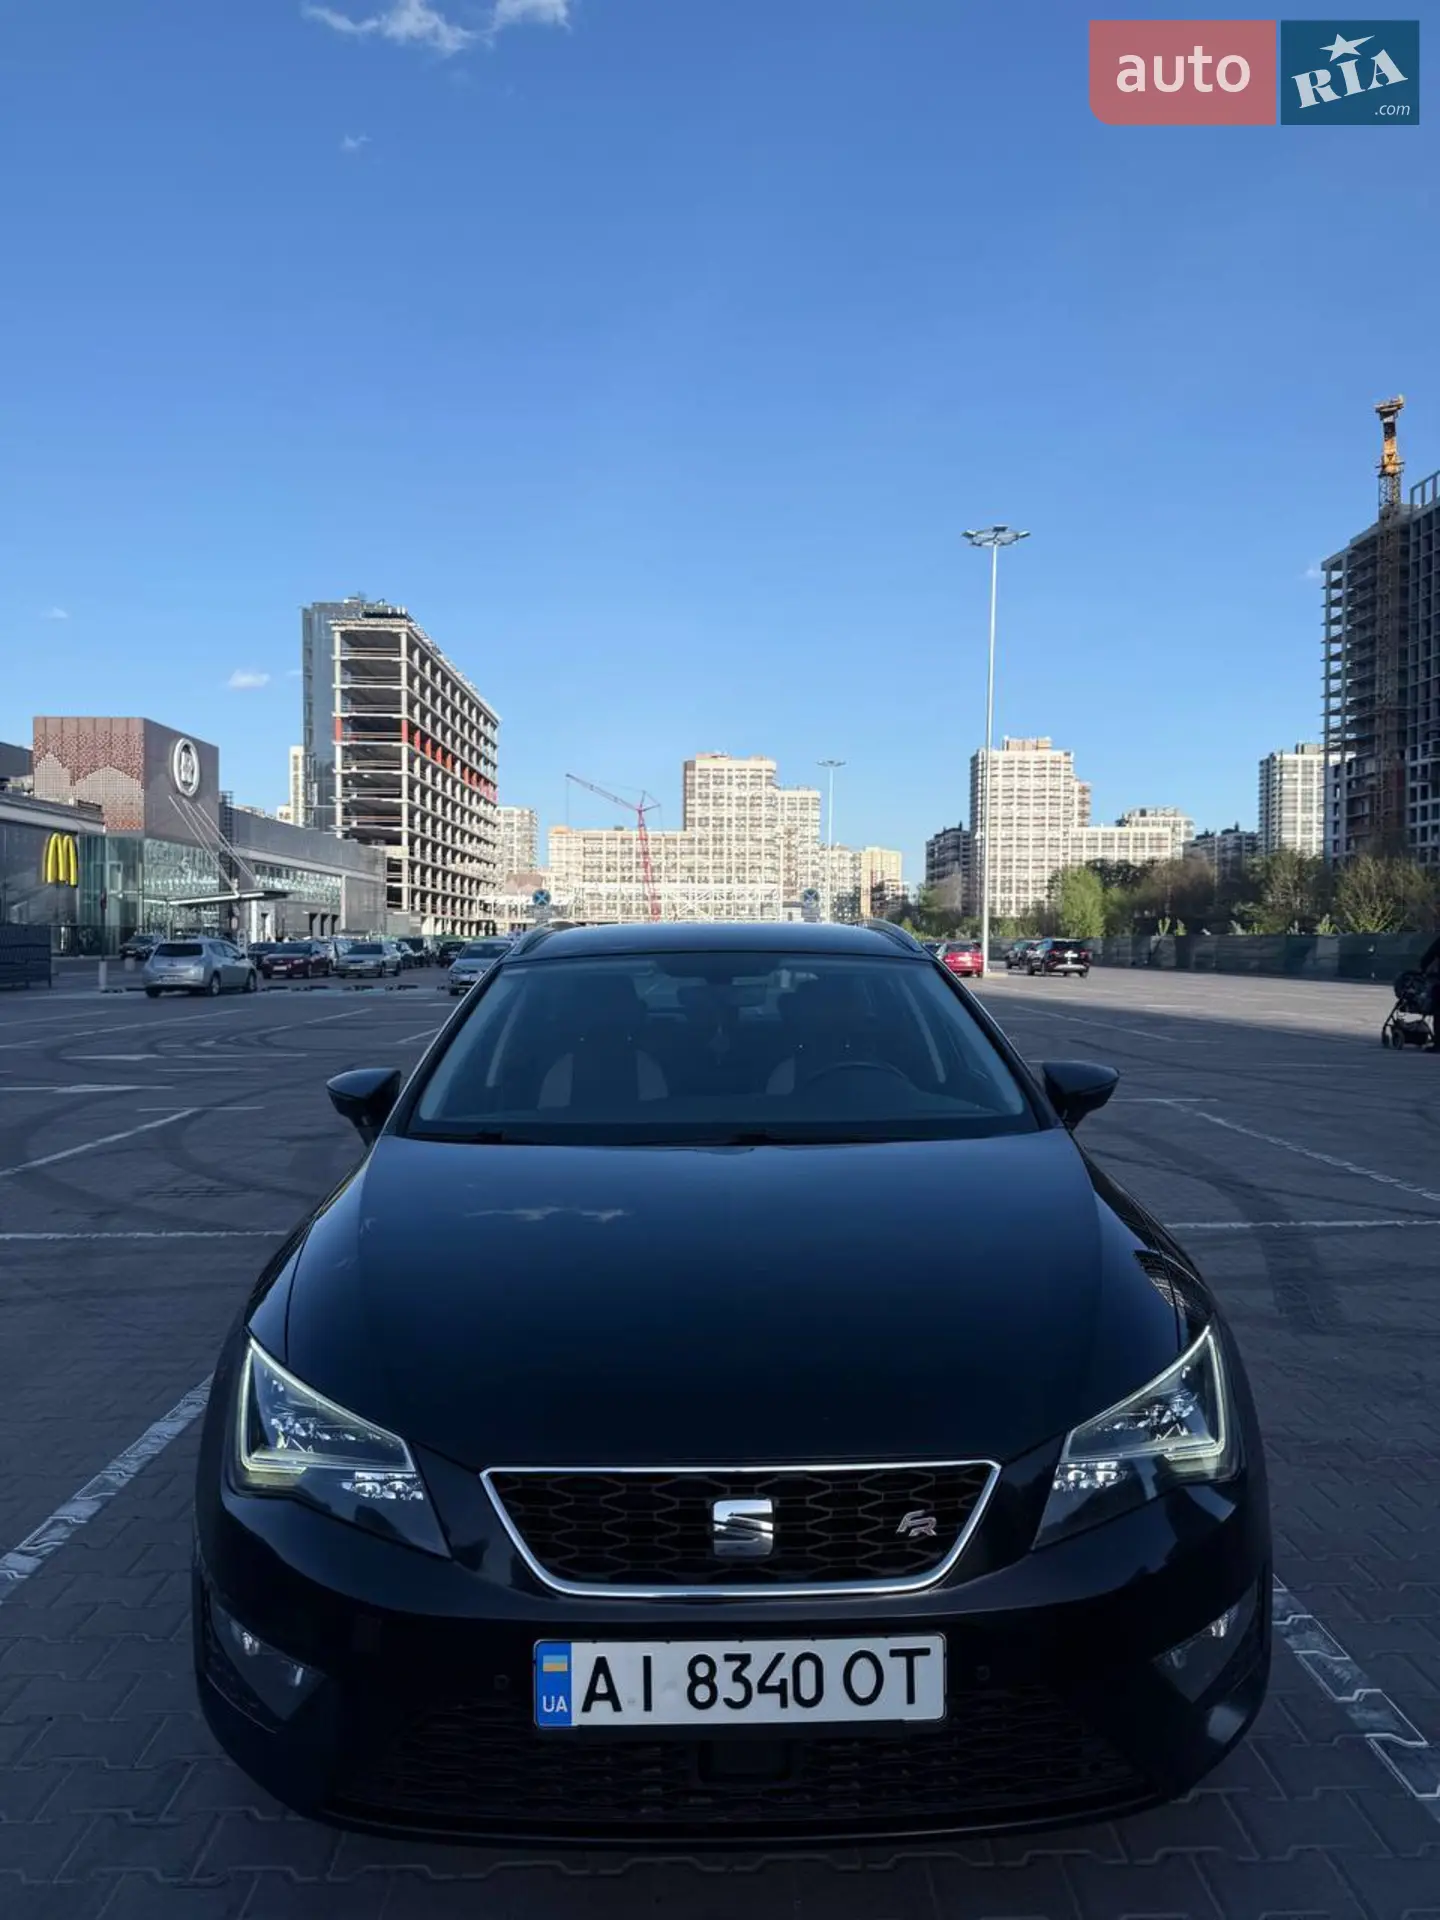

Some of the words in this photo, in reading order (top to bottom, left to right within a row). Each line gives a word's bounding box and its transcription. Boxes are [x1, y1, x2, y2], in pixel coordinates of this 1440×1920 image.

[896, 1509, 937, 1537] FR
[581, 1655, 652, 1712] AI
[687, 1652, 824, 1710] 8340
[842, 1648, 931, 1707] OT
[542, 1695, 568, 1713] UA
